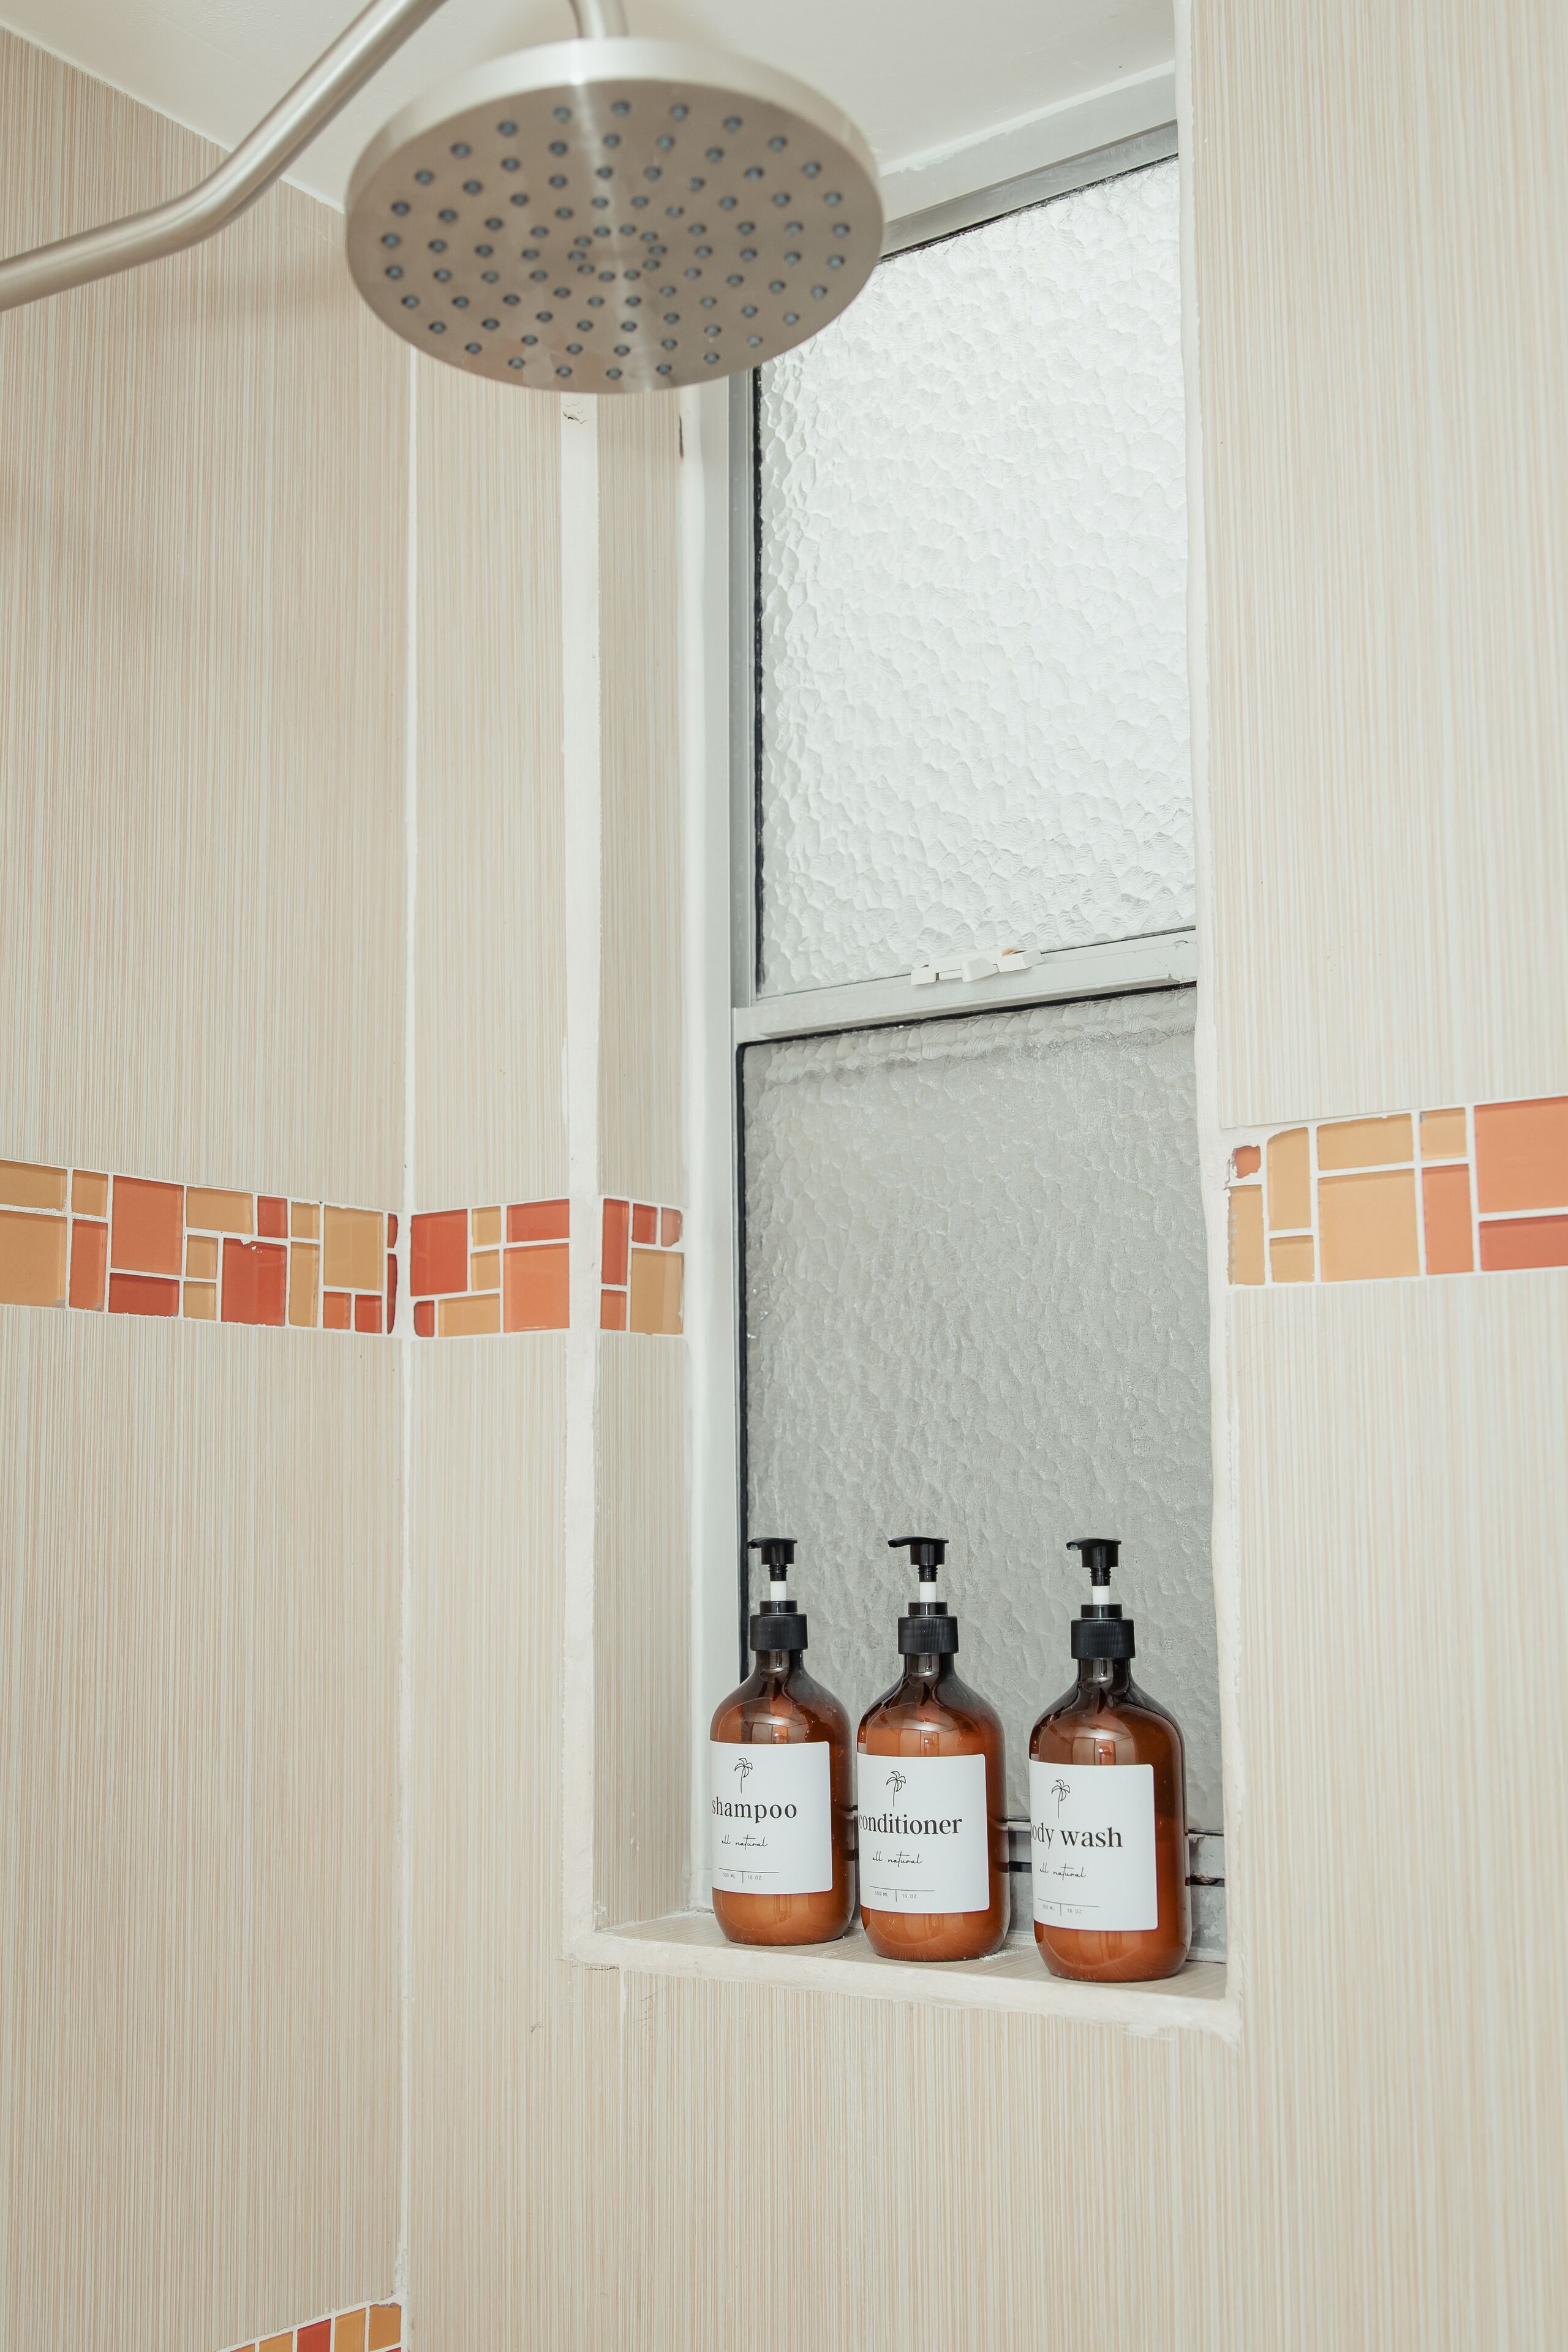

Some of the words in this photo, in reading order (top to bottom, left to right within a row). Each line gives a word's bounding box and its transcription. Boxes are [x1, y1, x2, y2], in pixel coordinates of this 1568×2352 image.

[712, 1796, 797, 1823] shampoo
[859, 1813, 962, 1834] conditioner
[736, 1834, 768, 1850] natural
[1060, 1826, 1123, 1848] wash
[872, 1851, 883, 1862] all
[888, 1851, 922, 1868] natural
[1053, 1863, 1087, 1880] natural
